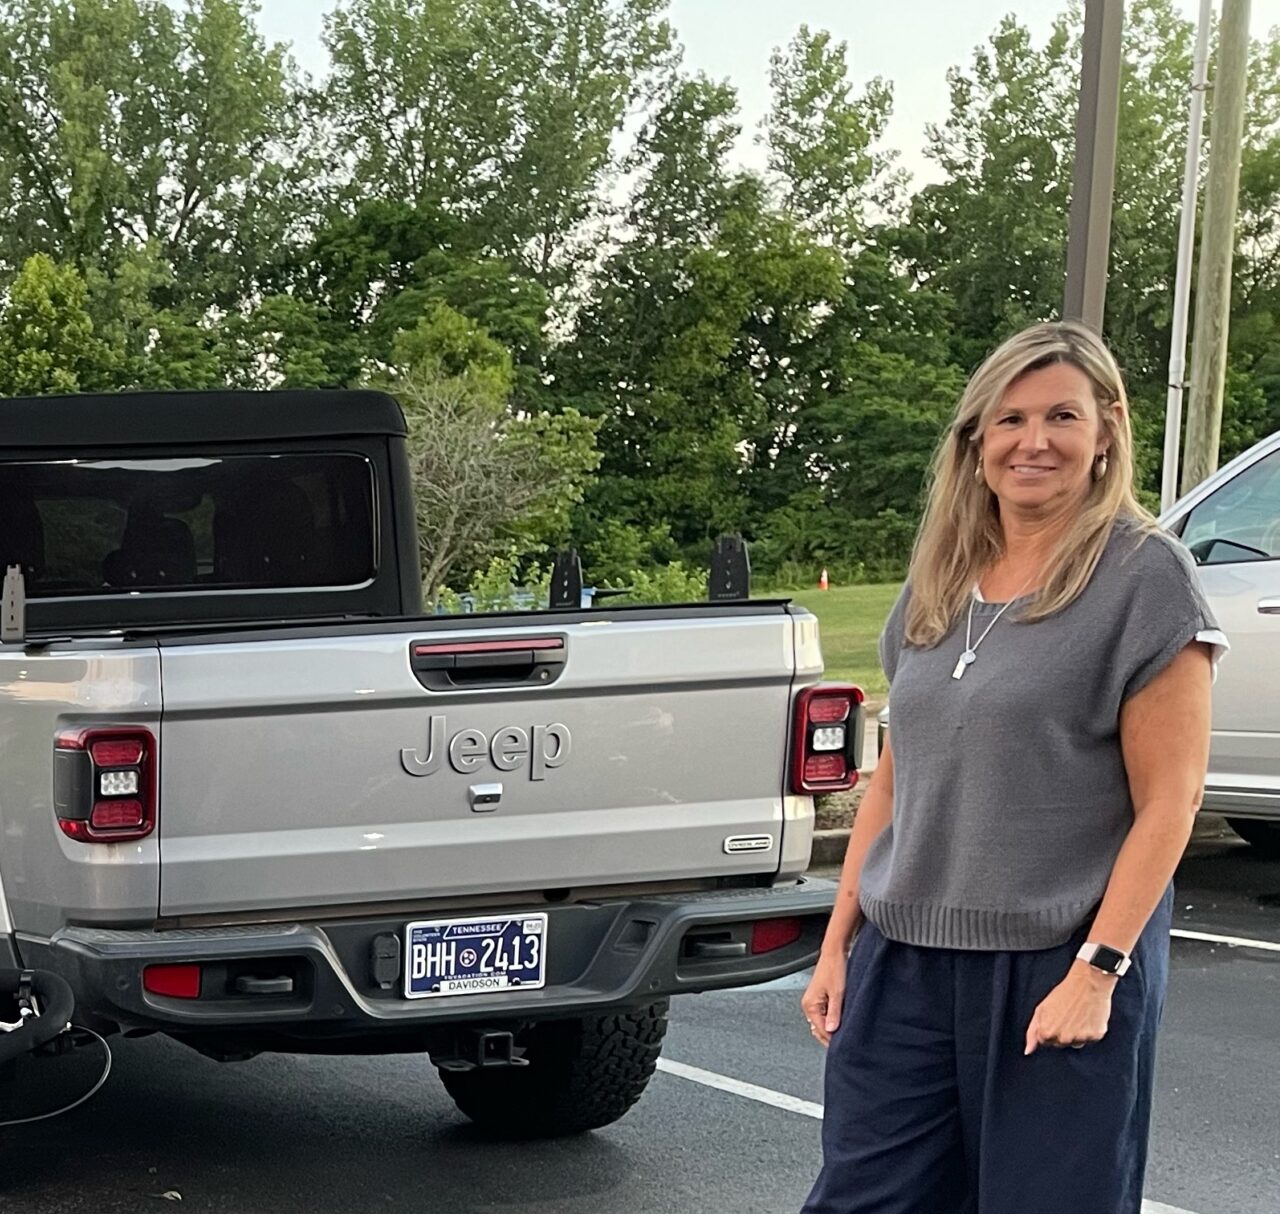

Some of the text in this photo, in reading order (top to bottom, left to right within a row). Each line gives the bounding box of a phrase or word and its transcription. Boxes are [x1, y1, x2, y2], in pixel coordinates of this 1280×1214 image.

[401, 715, 572, 781] Jeep
[452, 923, 503, 934] TENNESSEE
[412, 935, 540, 979] BHH 2413
[448, 978, 500, 990] DAVIDSON
